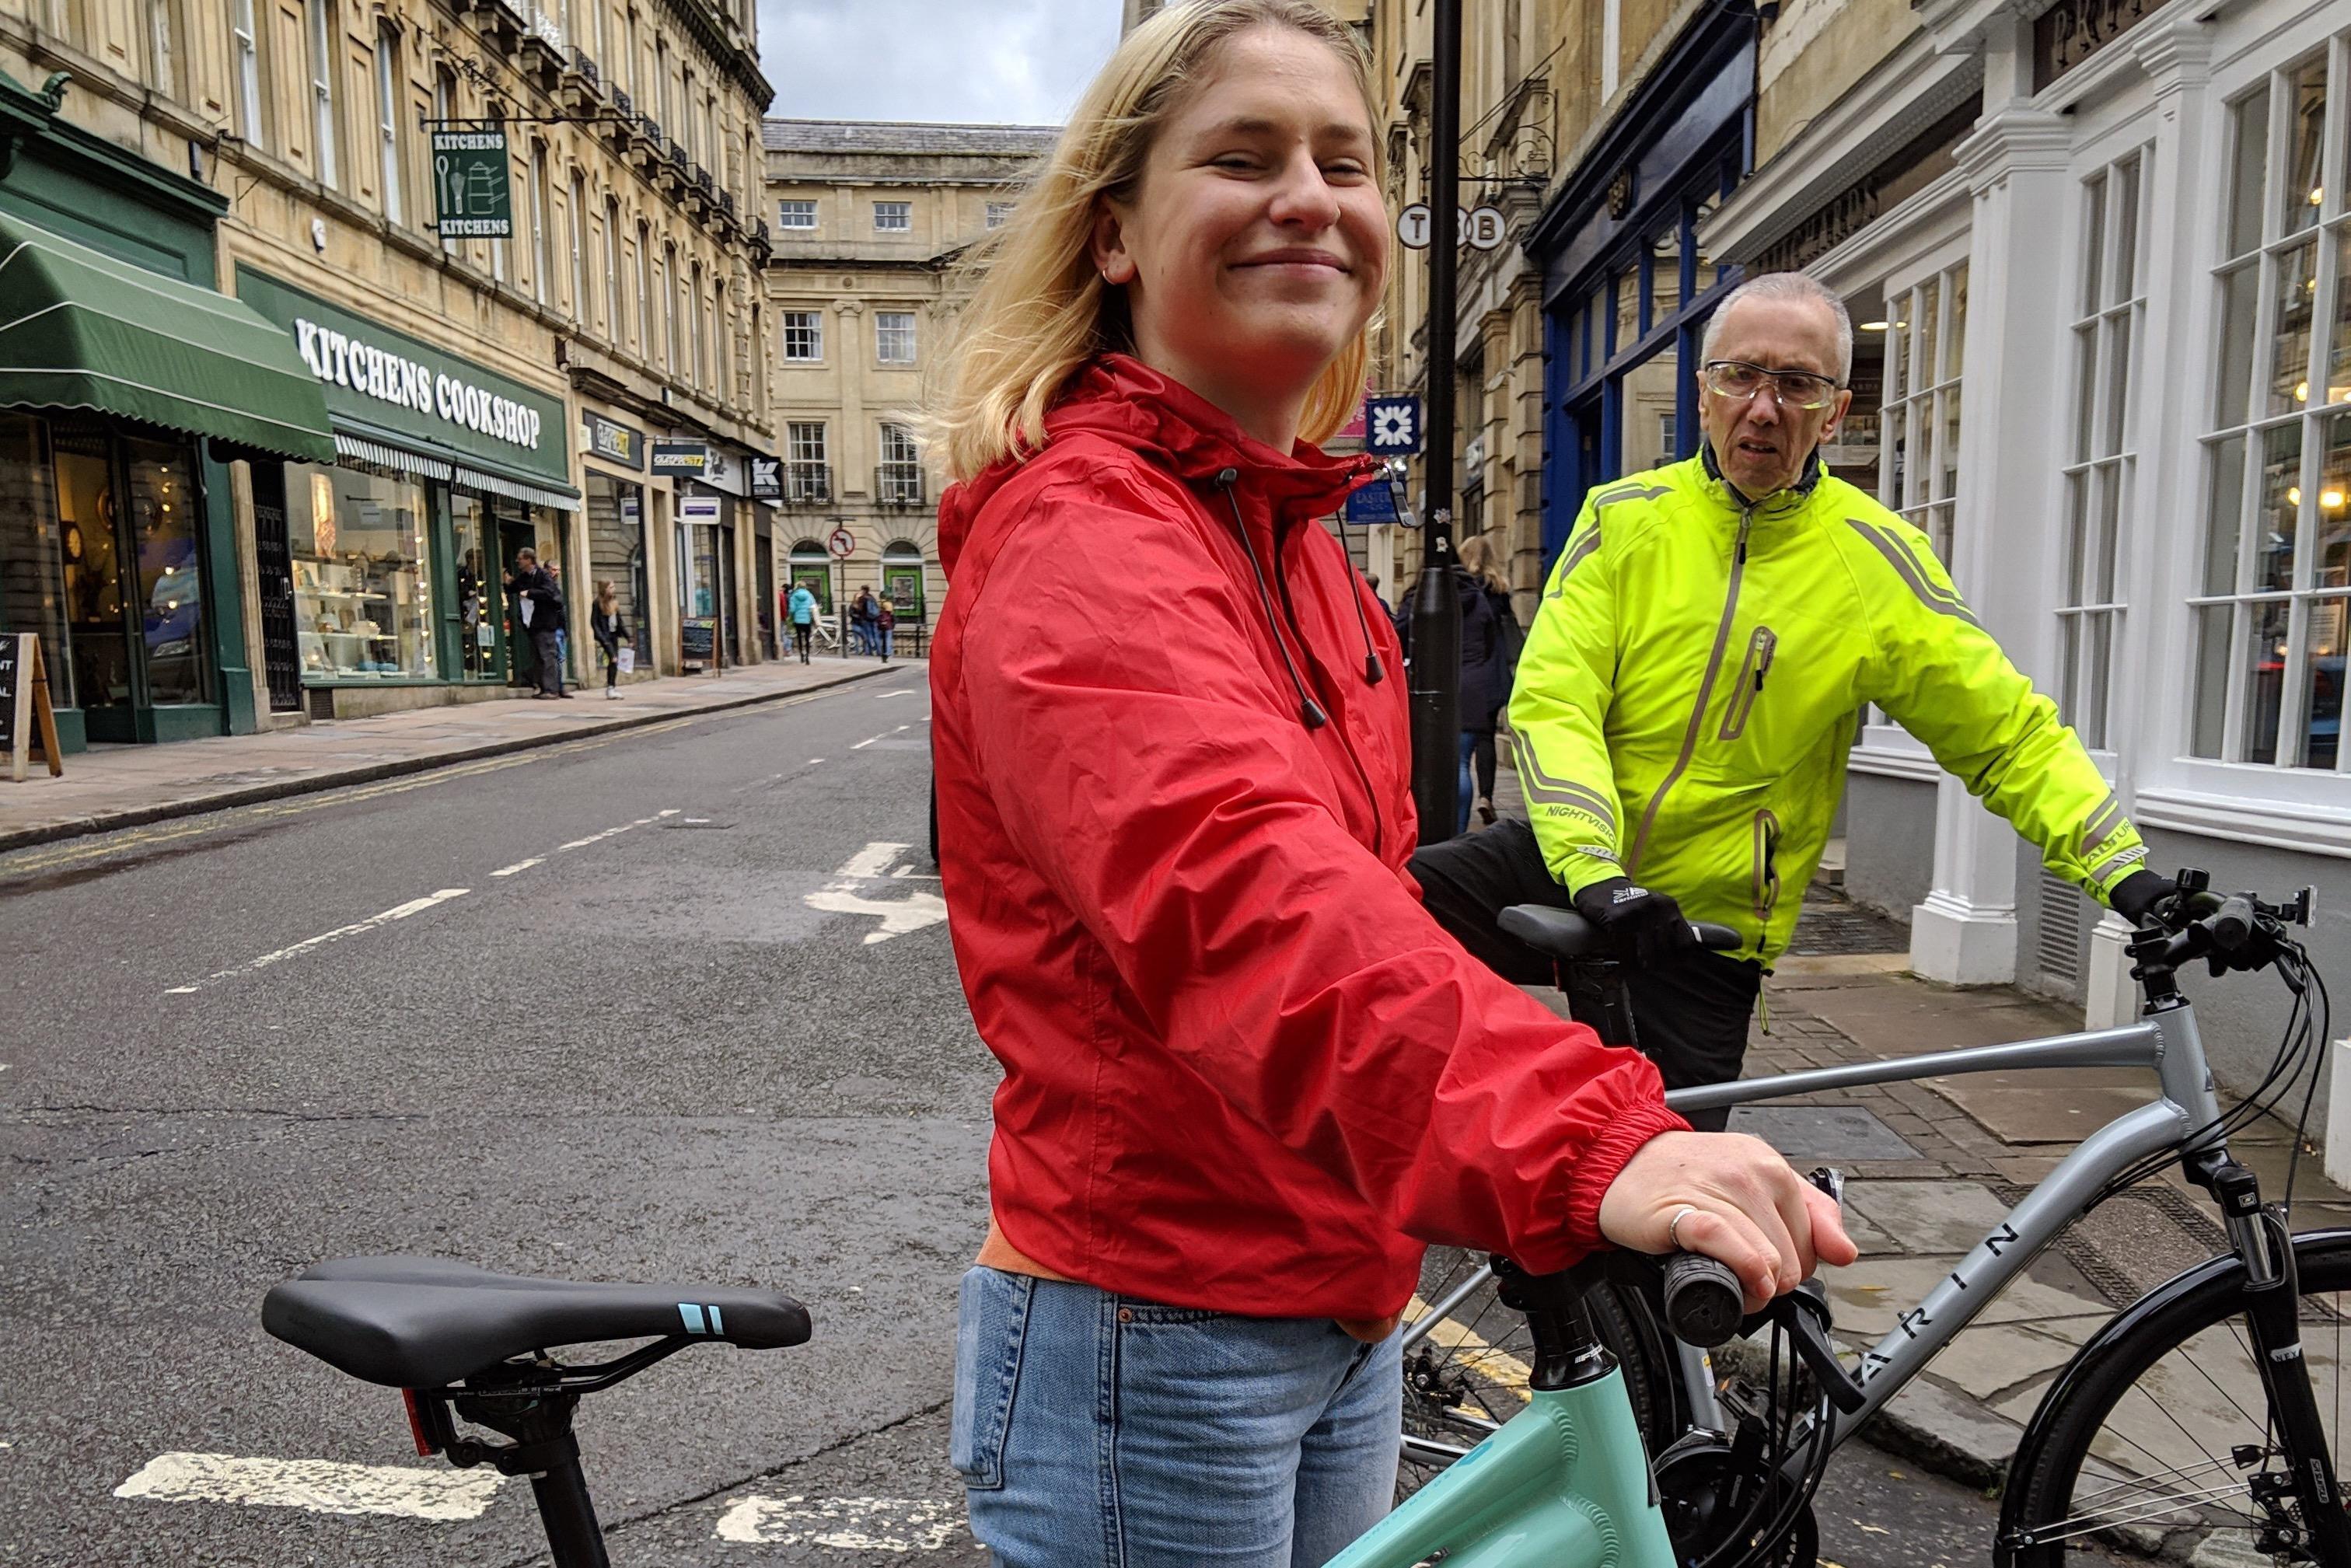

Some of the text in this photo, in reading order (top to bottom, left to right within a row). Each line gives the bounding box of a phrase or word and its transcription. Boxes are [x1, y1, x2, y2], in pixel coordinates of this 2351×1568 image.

[434, 134, 504, 150] KITCHENS
[439, 218, 509, 235] KITCHENS
[1410, 213, 1496, 240] TB
[295, 317, 540, 450] KITCHENS COOKSHOP
[1546, 805, 1617, 846] NIGHTVISIO
[2087, 821, 2133, 865] ALTUR
